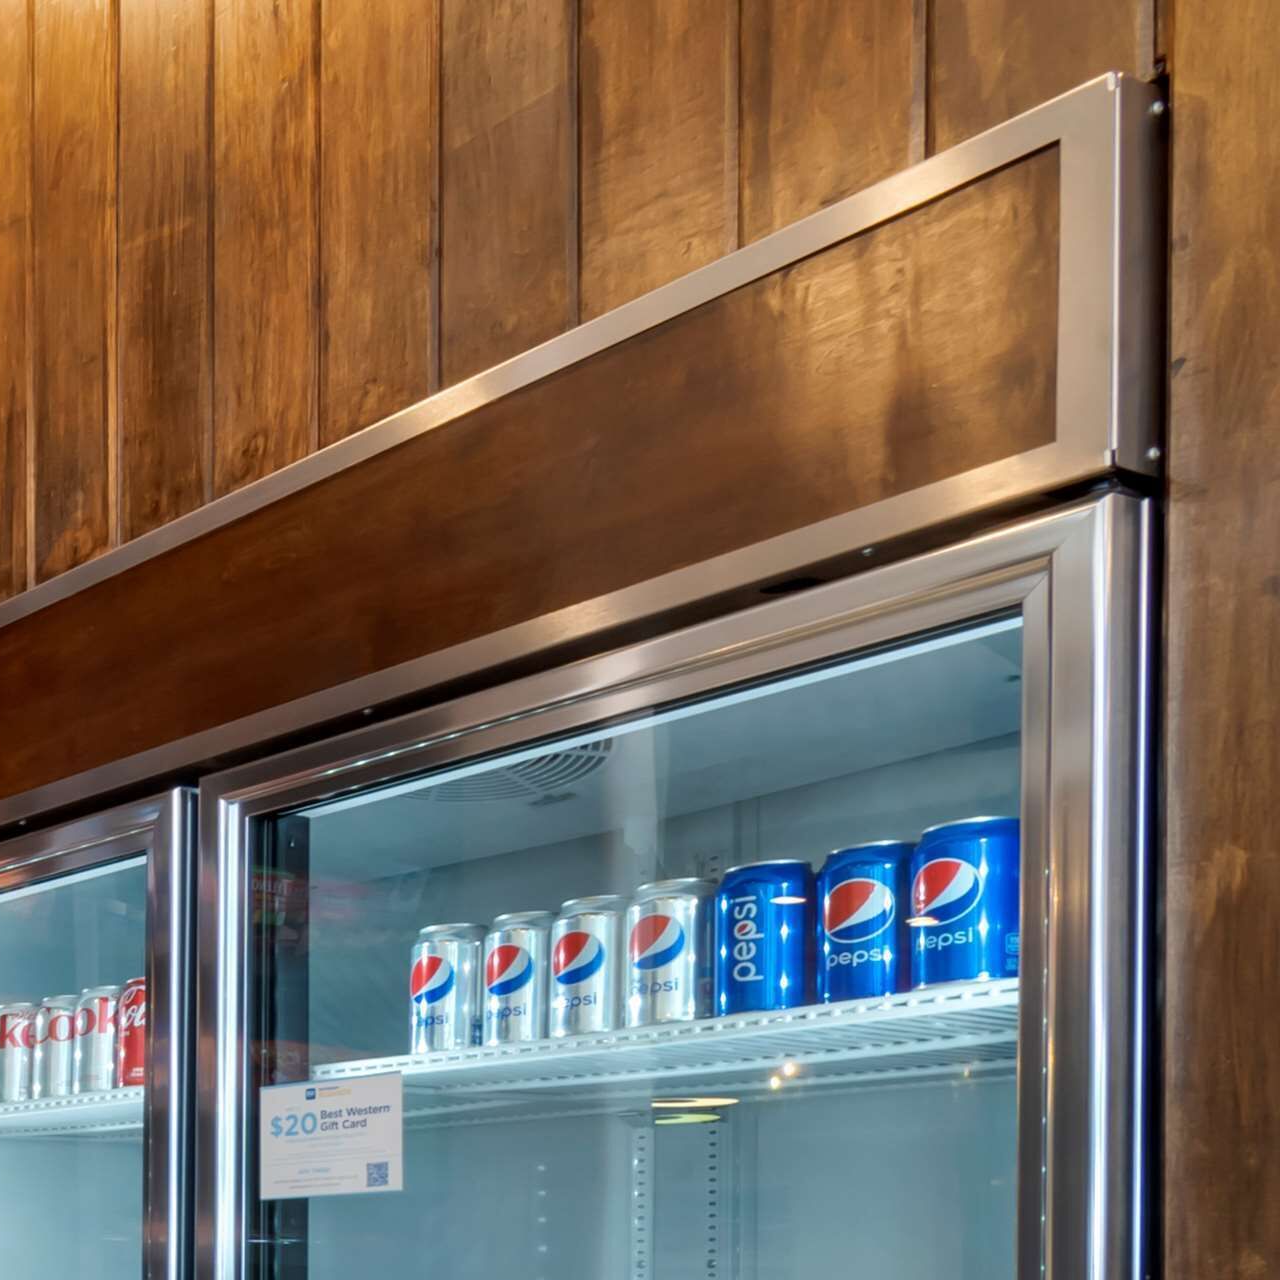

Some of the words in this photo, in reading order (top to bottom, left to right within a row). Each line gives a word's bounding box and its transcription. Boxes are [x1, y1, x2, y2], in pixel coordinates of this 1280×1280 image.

[732, 895, 765, 983] pepsi
[915, 927, 974, 953] pepsi
[826, 946, 893, 971] pepsi
[559, 991, 598, 1009] epsi
[320, 1109, 343, 1120] Best
[346, 1103, 391, 1118] Western
[270, 1111, 318, 1138] $20
[320, 1120, 339, 1131] Gift
[342, 1118, 367, 1129] Card
